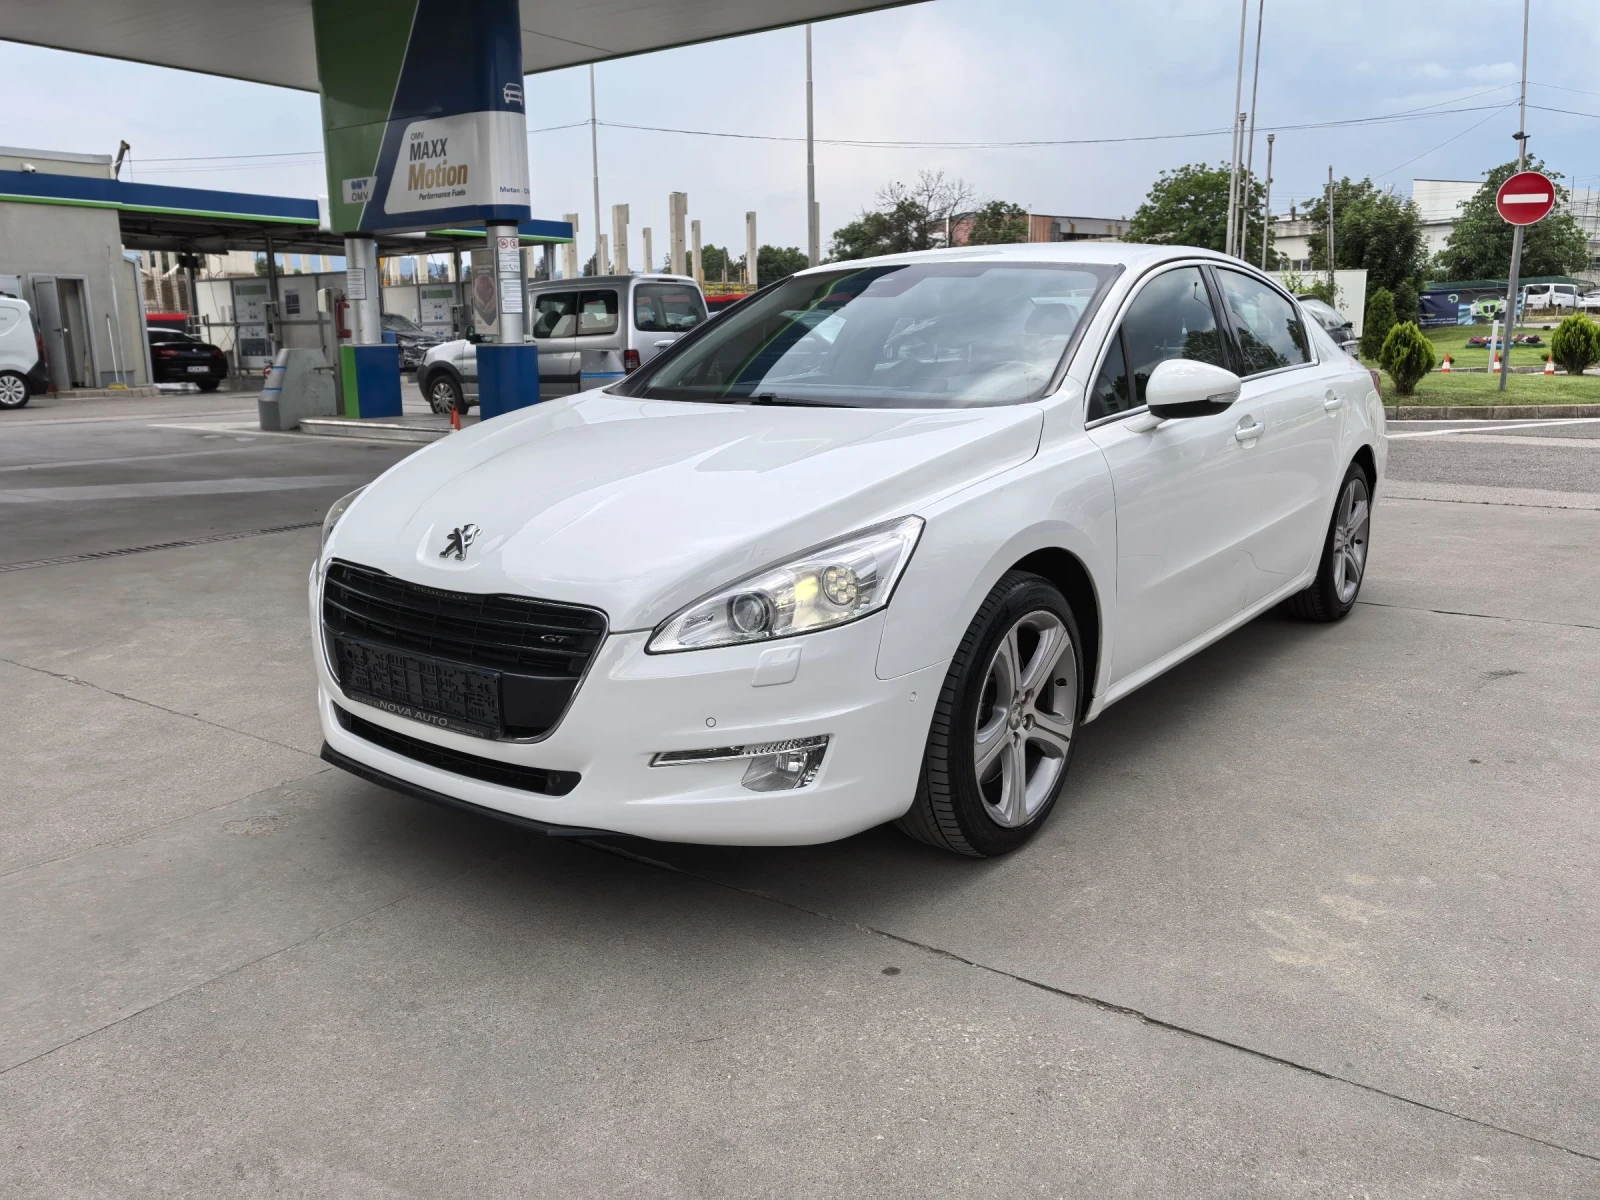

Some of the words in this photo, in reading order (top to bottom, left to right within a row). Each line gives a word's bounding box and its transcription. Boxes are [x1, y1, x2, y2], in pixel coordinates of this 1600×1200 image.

[410, 131, 425, 141] OMV
[409, 137, 448, 162] MAXX
[407, 159, 469, 191] Motion
[351, 191, 369, 202] OMV
[418, 191, 451, 201] Performance
[451, 188, 466, 197] Fuels
[540, 634, 571, 643] GT
[379, 700, 412, 717] NOVA
[414, 711, 448, 726] AUTO
